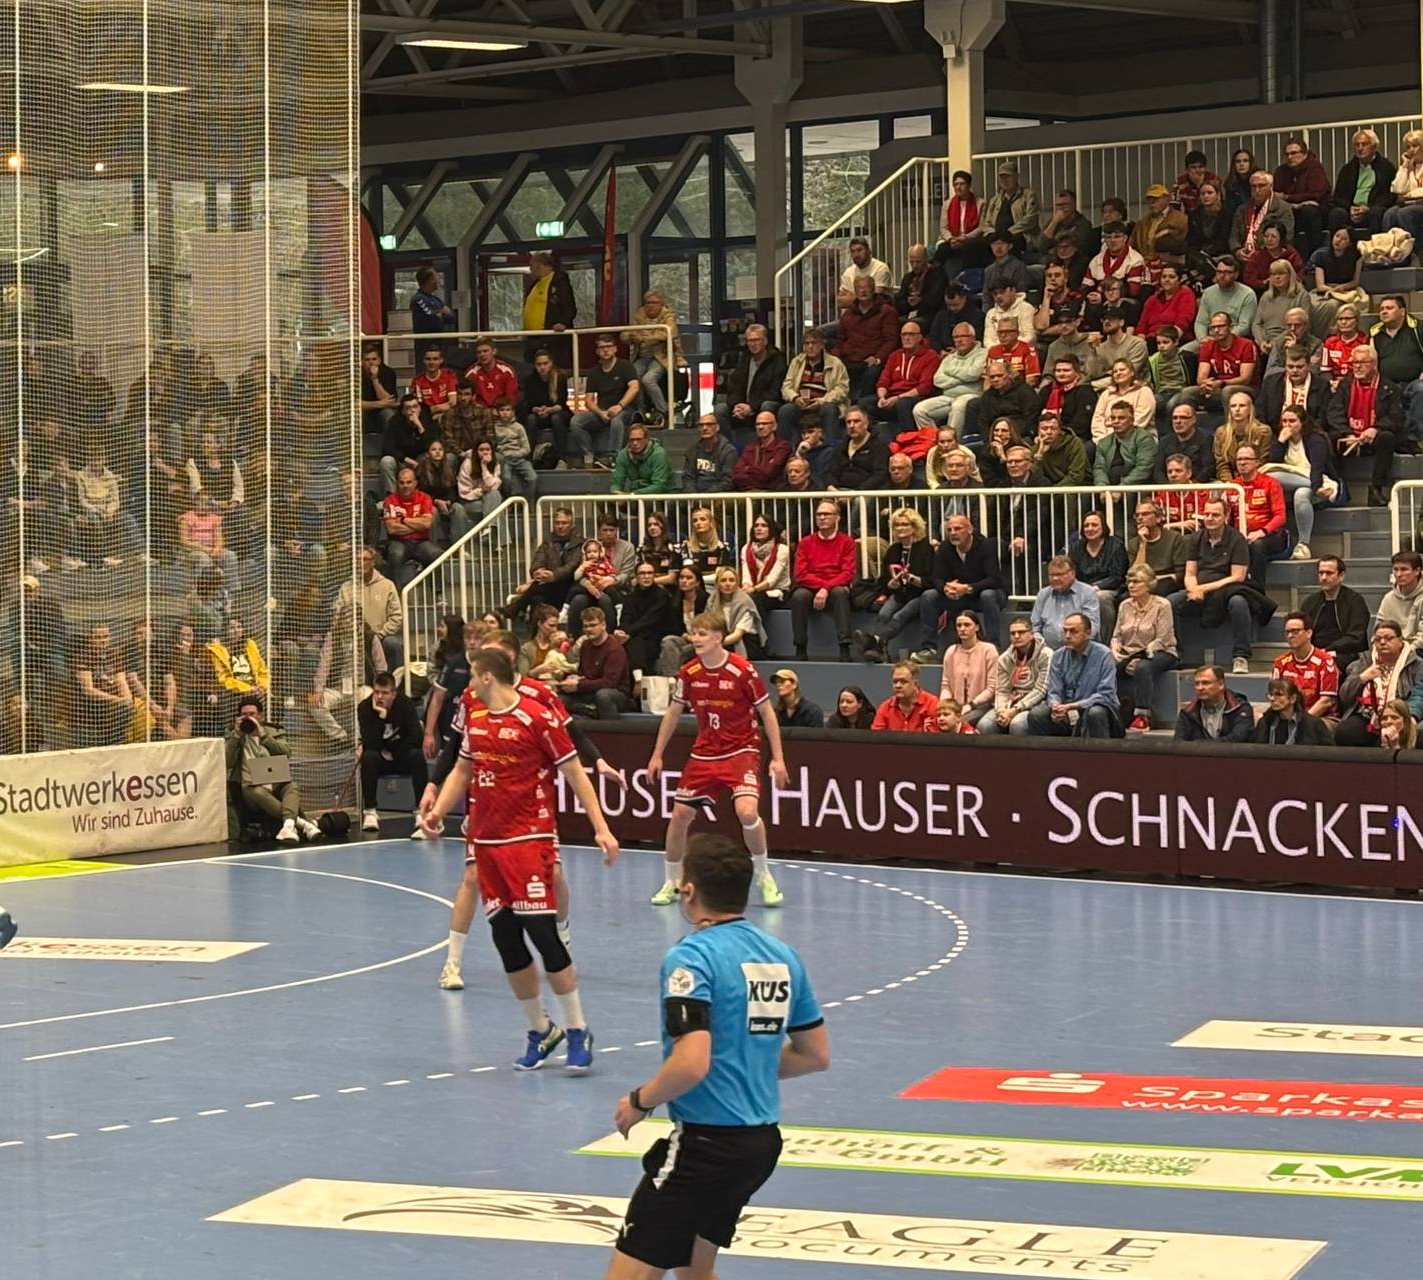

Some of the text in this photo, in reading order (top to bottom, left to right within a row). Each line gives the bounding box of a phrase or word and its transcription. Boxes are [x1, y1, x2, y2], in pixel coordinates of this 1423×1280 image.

[72, 805, 198, 834] Wir sind Zuhause.
[771, 766, 989, 838] HAUSER
[749, 981, 789, 1003] KÜS
[736, 1213, 1169, 1258] EAGLE
[731, 1237, 1133, 1273] ocuments
